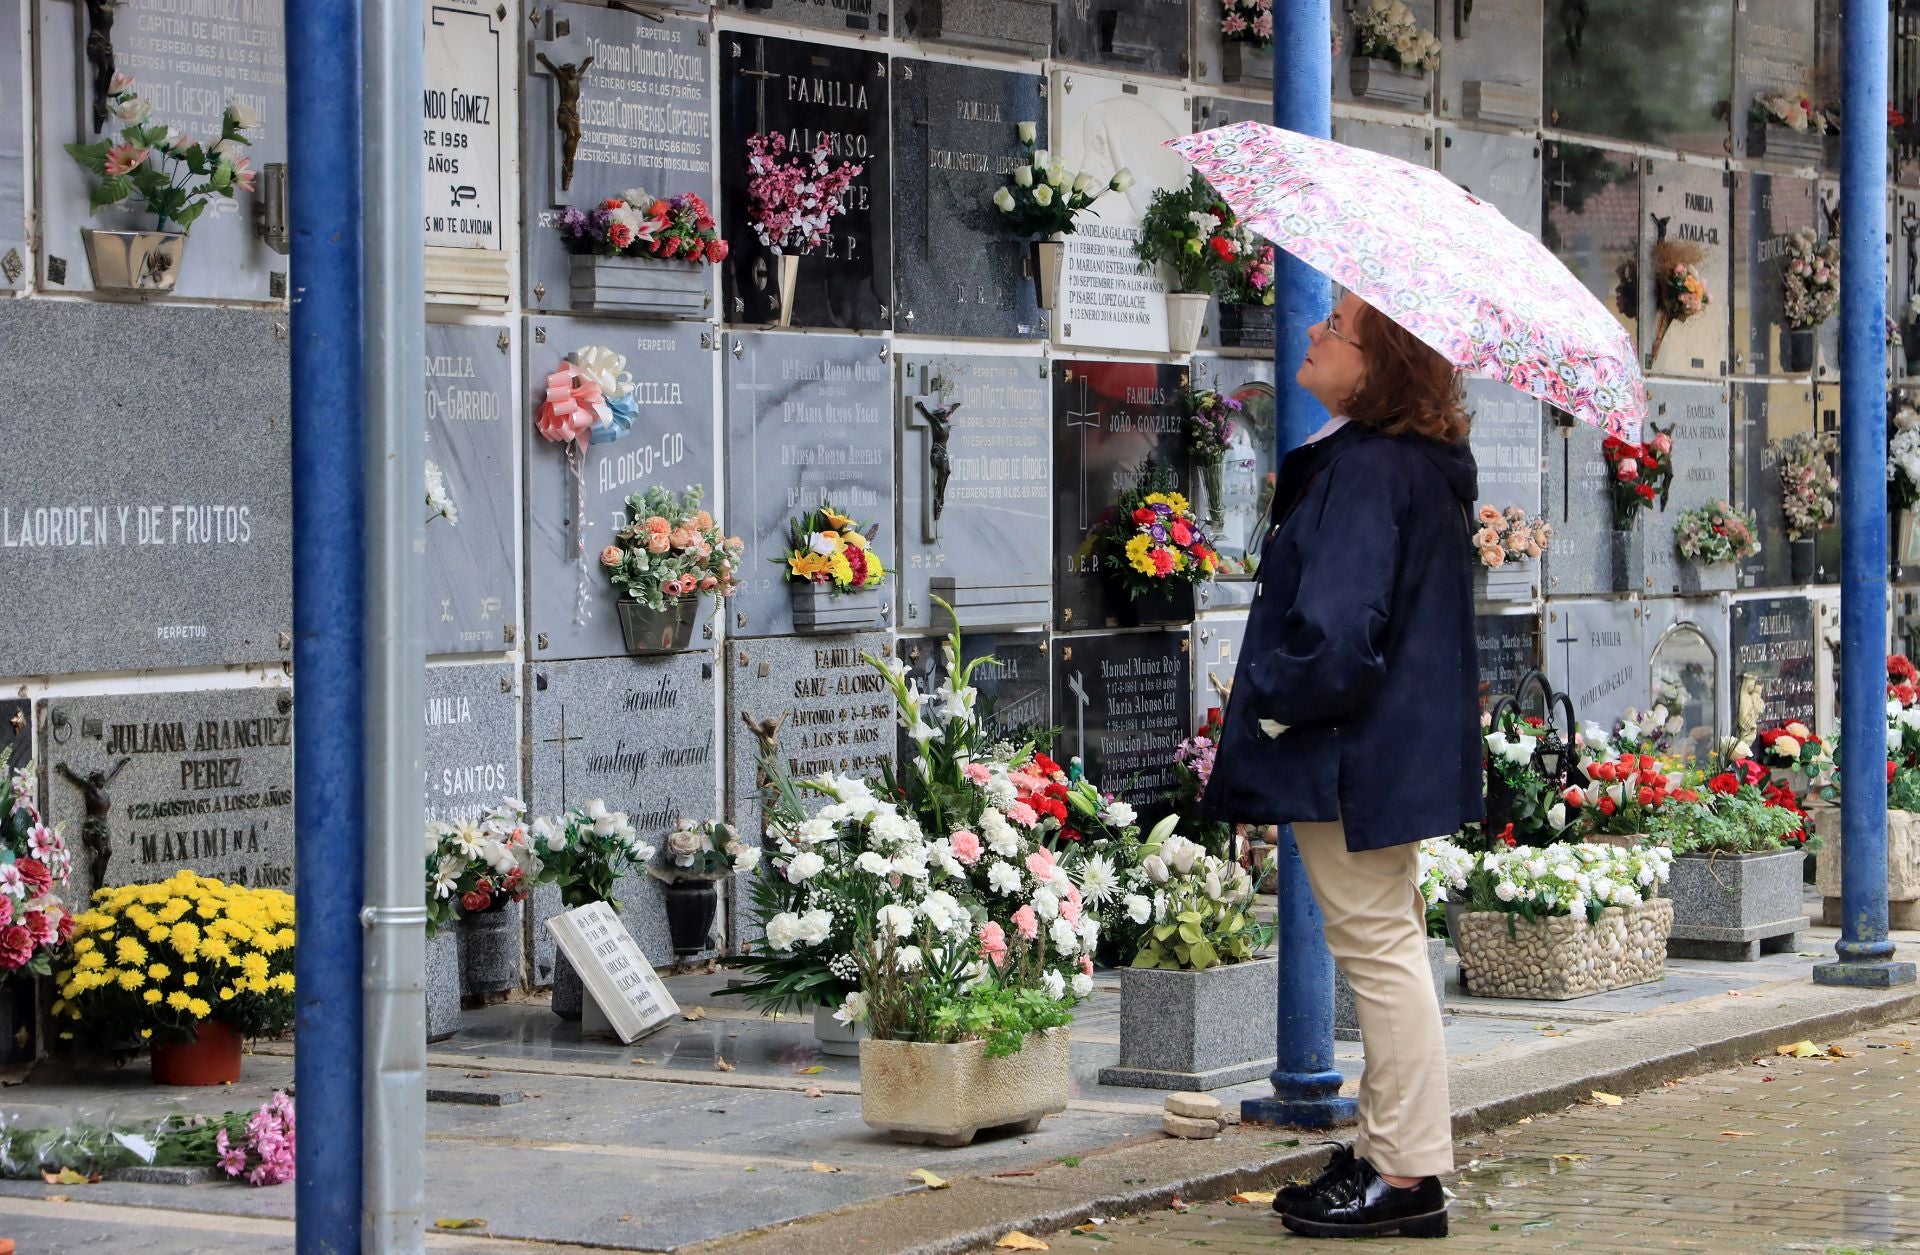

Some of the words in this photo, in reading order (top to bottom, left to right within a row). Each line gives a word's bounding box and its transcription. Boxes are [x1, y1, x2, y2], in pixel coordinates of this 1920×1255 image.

[138, 15, 188, 39] CAPITAN
[192, 21, 208, 39] DE
[211, 24, 279, 47] ARTILLERIA
[635, 25, 672, 42] PERPETUO
[149, 38, 193, 56] FEBRERO
[195, 44, 217, 58] 1965
[227, 49, 246, 62] LOS
[131, 54, 166, 71] ESPOSA
[175, 59, 223, 77] HERMANOS
[667, 49, 705, 83] PASCUAL
[601, 79, 626, 92] ENERO
[788, 75, 869, 110] FAMILIA
[174, 81, 221, 118] CRESPO
[956, 101, 1001, 123] FAMILIA
[441, 132, 469, 149] 1958
[789, 128, 868, 159] ALONSO
[428, 153, 460, 174] AÑOS
[930, 149, 990, 175] DOMINGUEZ
[434, 217, 446, 232] NO
[447, 219, 457, 233] TE
[460, 219, 493, 236] OLVIDAN
[1079, 242, 1106, 256] FEBRERO
[1076, 258, 1106, 273] MARIANO
[1080, 276, 1115, 290] SEPTIEMBRE
[1076, 290, 1098, 306] ISABEL
[1117, 294, 1147, 310] GALACHE
[1081, 309, 1101, 321] ENERO
[1126, 386, 1166, 405] FAMILIAS
[599, 432, 685, 495] ALONSO-CID
[117, 504, 132, 546] Y
[138, 504, 166, 545] DE
[171, 503, 254, 544] FRUTOS
[156, 625, 208, 641] PERPETUO
[794, 677, 828, 698] SANZ
[836, 672, 886, 696] ALONSO
[792, 707, 835, 727] ANTONIO
[107, 720, 188, 755] JULIANA
[194, 716, 291, 751] ARANGUEZ
[852, 725, 880, 744] AÑOS
[180, 757, 243, 790] PEREZ
[442, 762, 506, 797] SANTOS
[151, 799, 197, 819] AGOSTO
